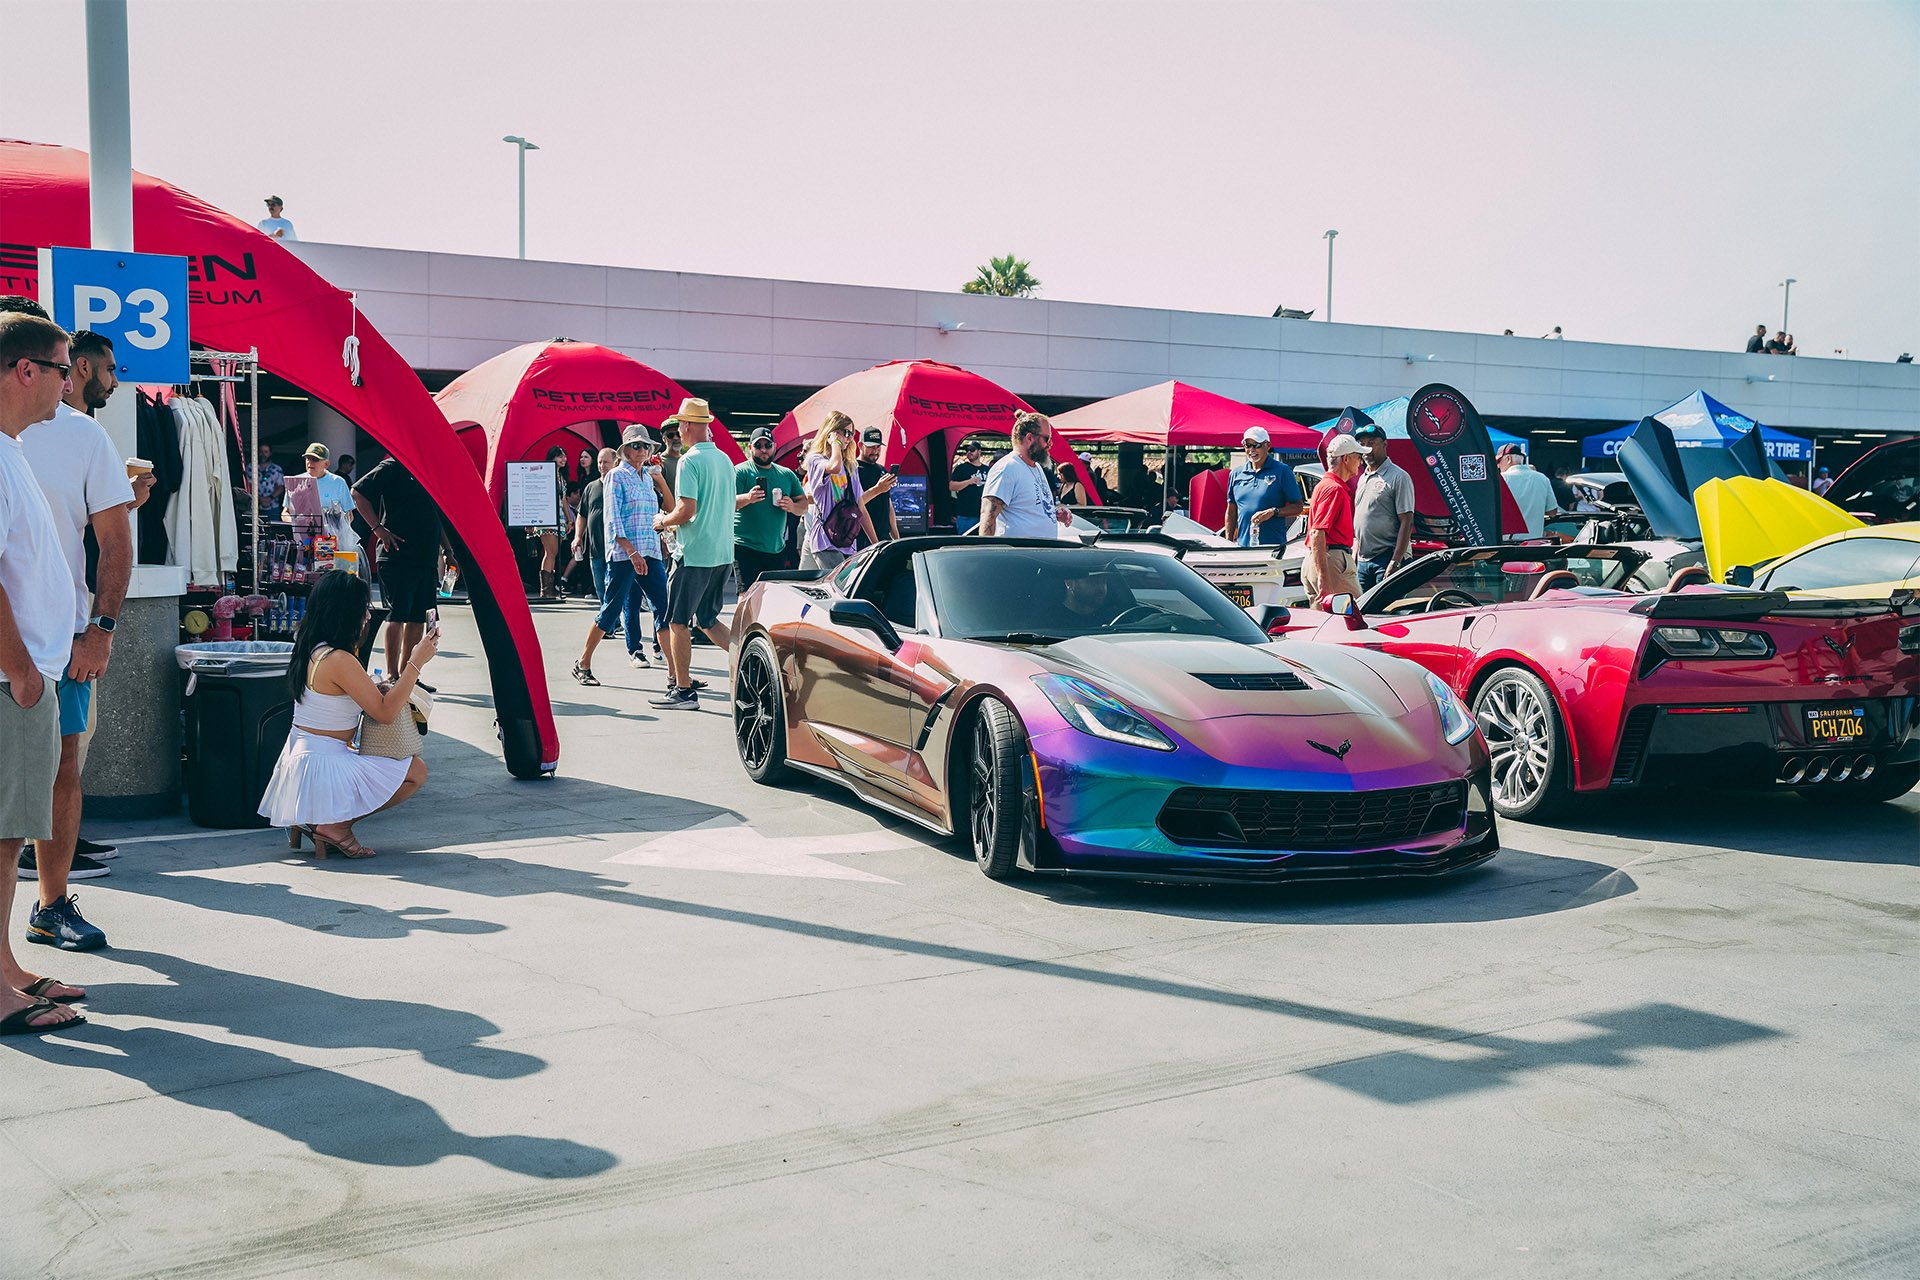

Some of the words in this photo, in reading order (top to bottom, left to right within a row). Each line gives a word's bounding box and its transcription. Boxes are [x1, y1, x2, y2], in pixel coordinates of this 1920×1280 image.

[74, 284, 171, 350] P3
[532, 388, 671, 403] PETERSEN
[536, 402, 613, 412] AUTOMOTIVE
[617, 403, 673, 412] MUSEUM
[908, 395, 1017, 413] PETERSEN
[912, 409, 973, 420] AUTOMOTIVE
[1775, 442, 1800, 458] TIRE
[1812, 718, 1838, 738] PCH
